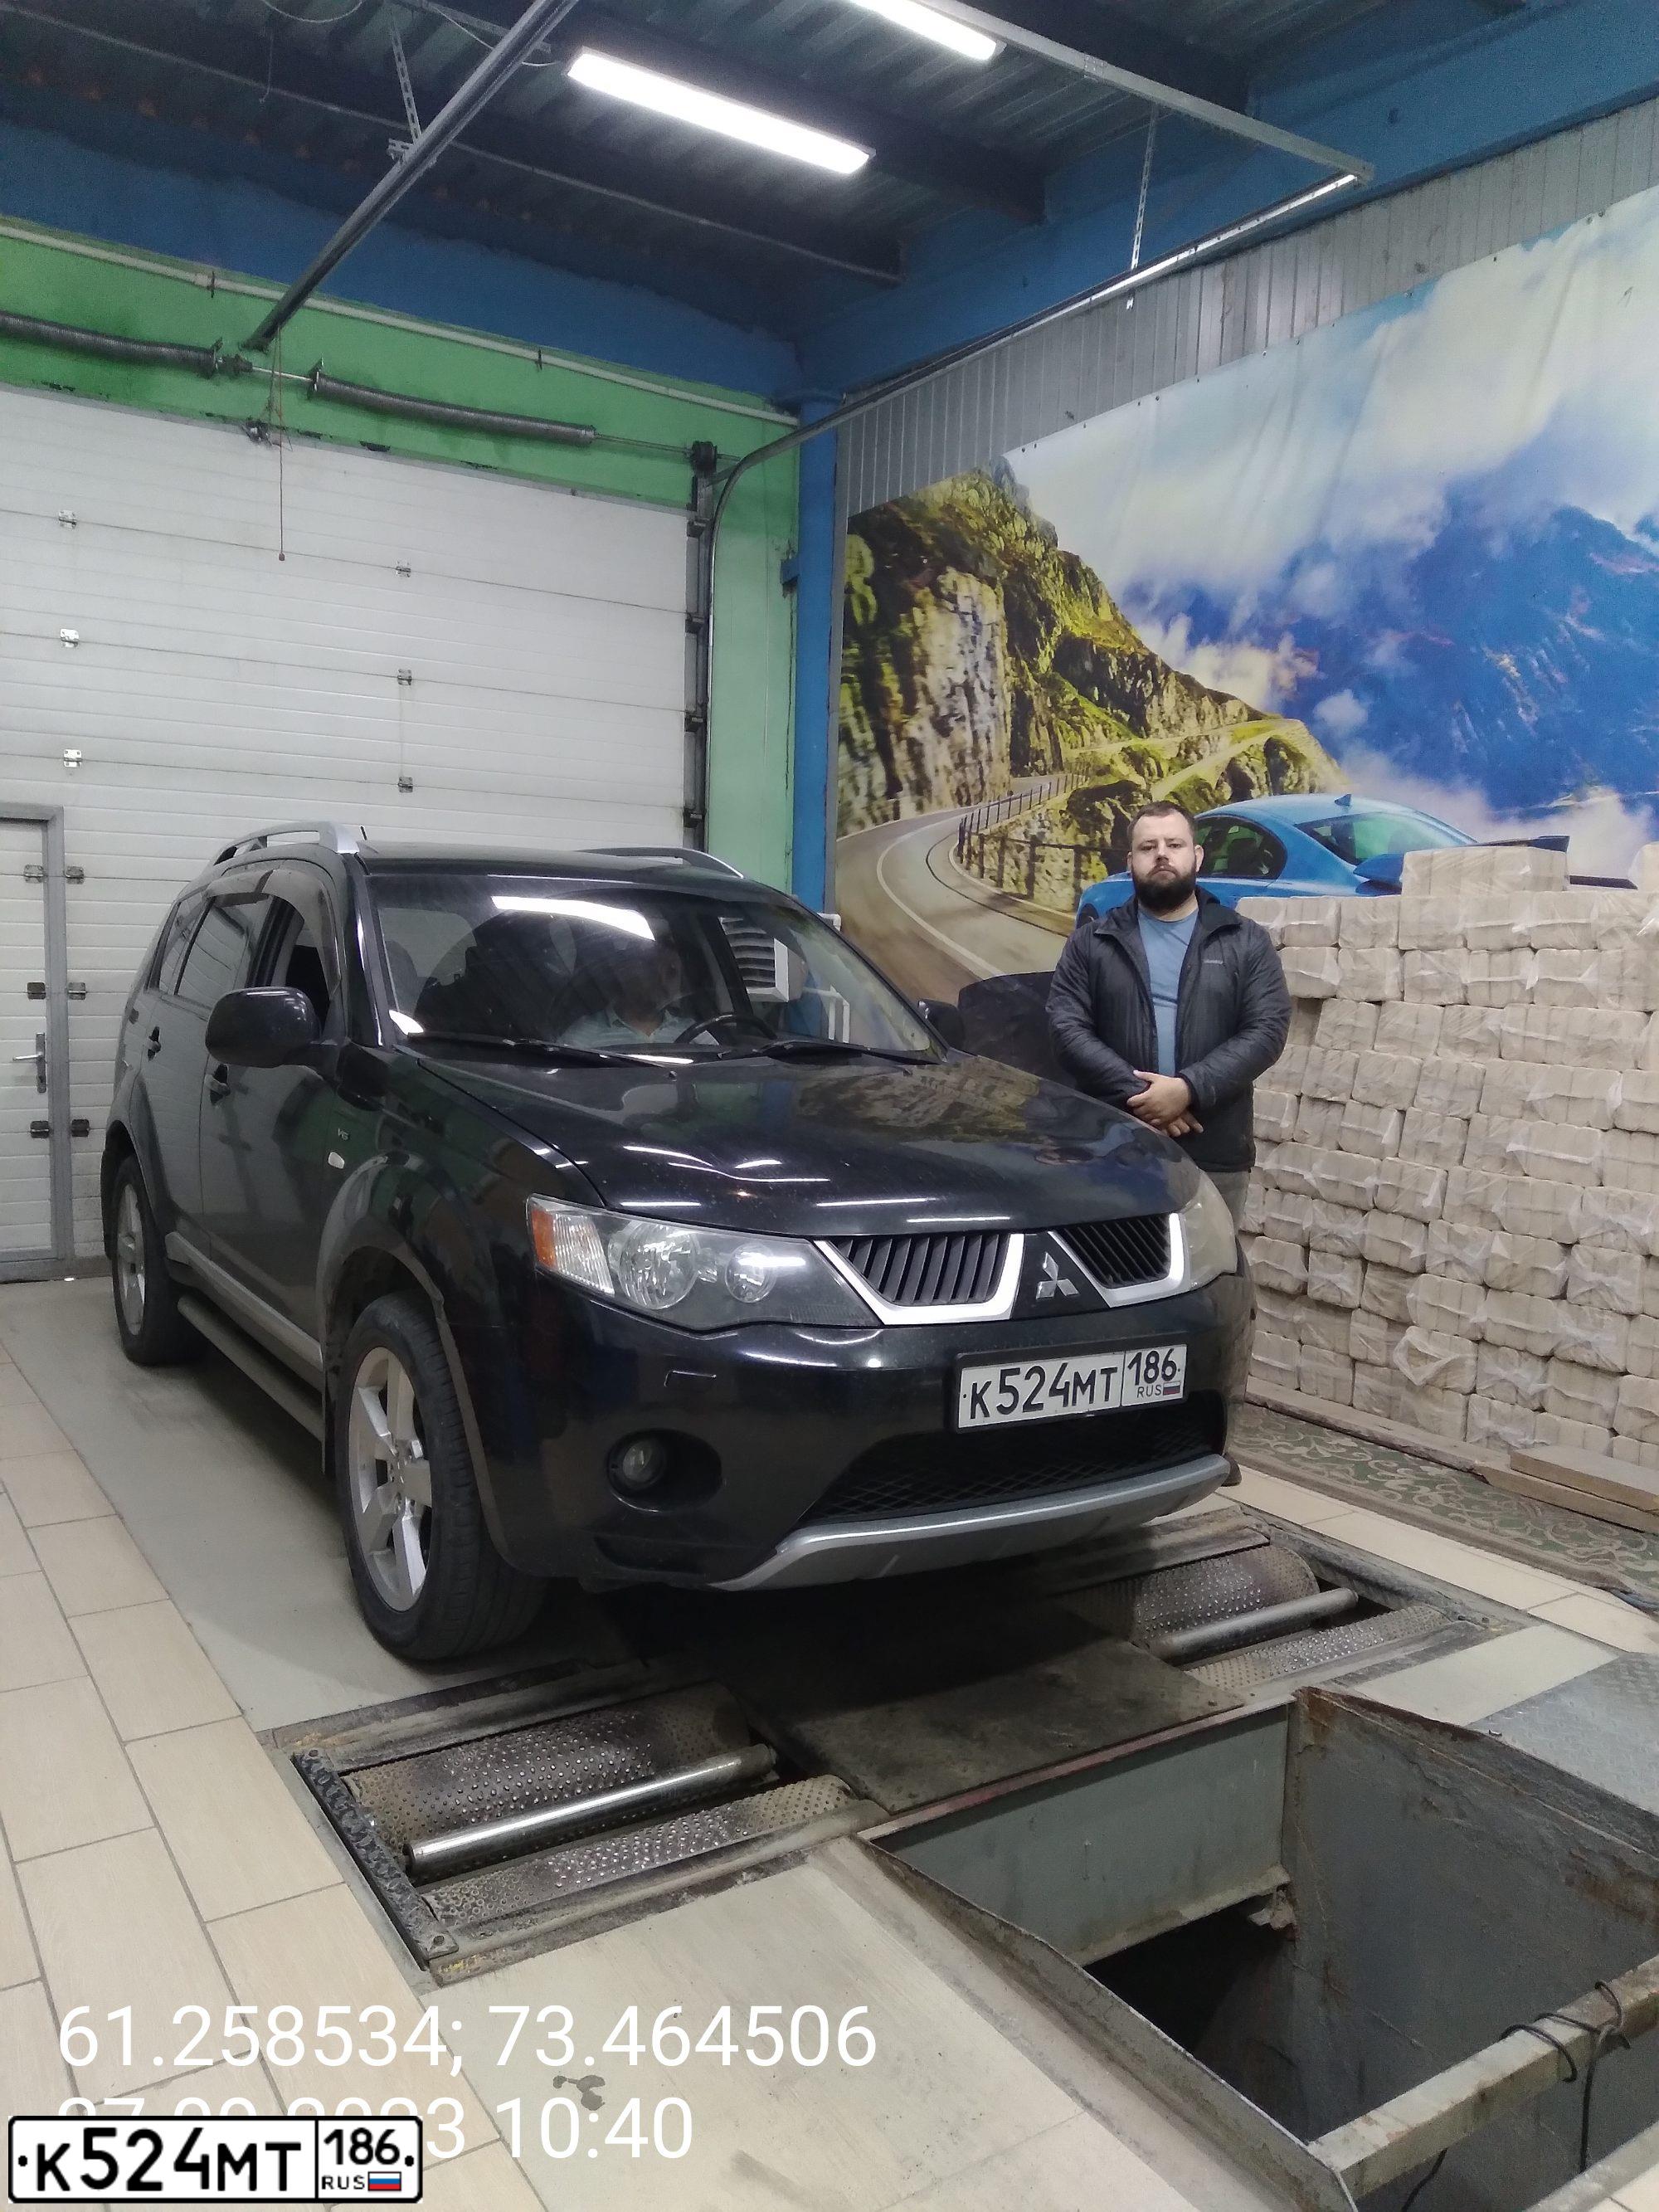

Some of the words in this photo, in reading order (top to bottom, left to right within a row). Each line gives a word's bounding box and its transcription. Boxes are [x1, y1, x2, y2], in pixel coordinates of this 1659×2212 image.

[970, 1362, 1118, 1420] К524МТ
[1127, 1348, 1177, 1386] 186
[1137, 1385, 1162, 1399] RUS
